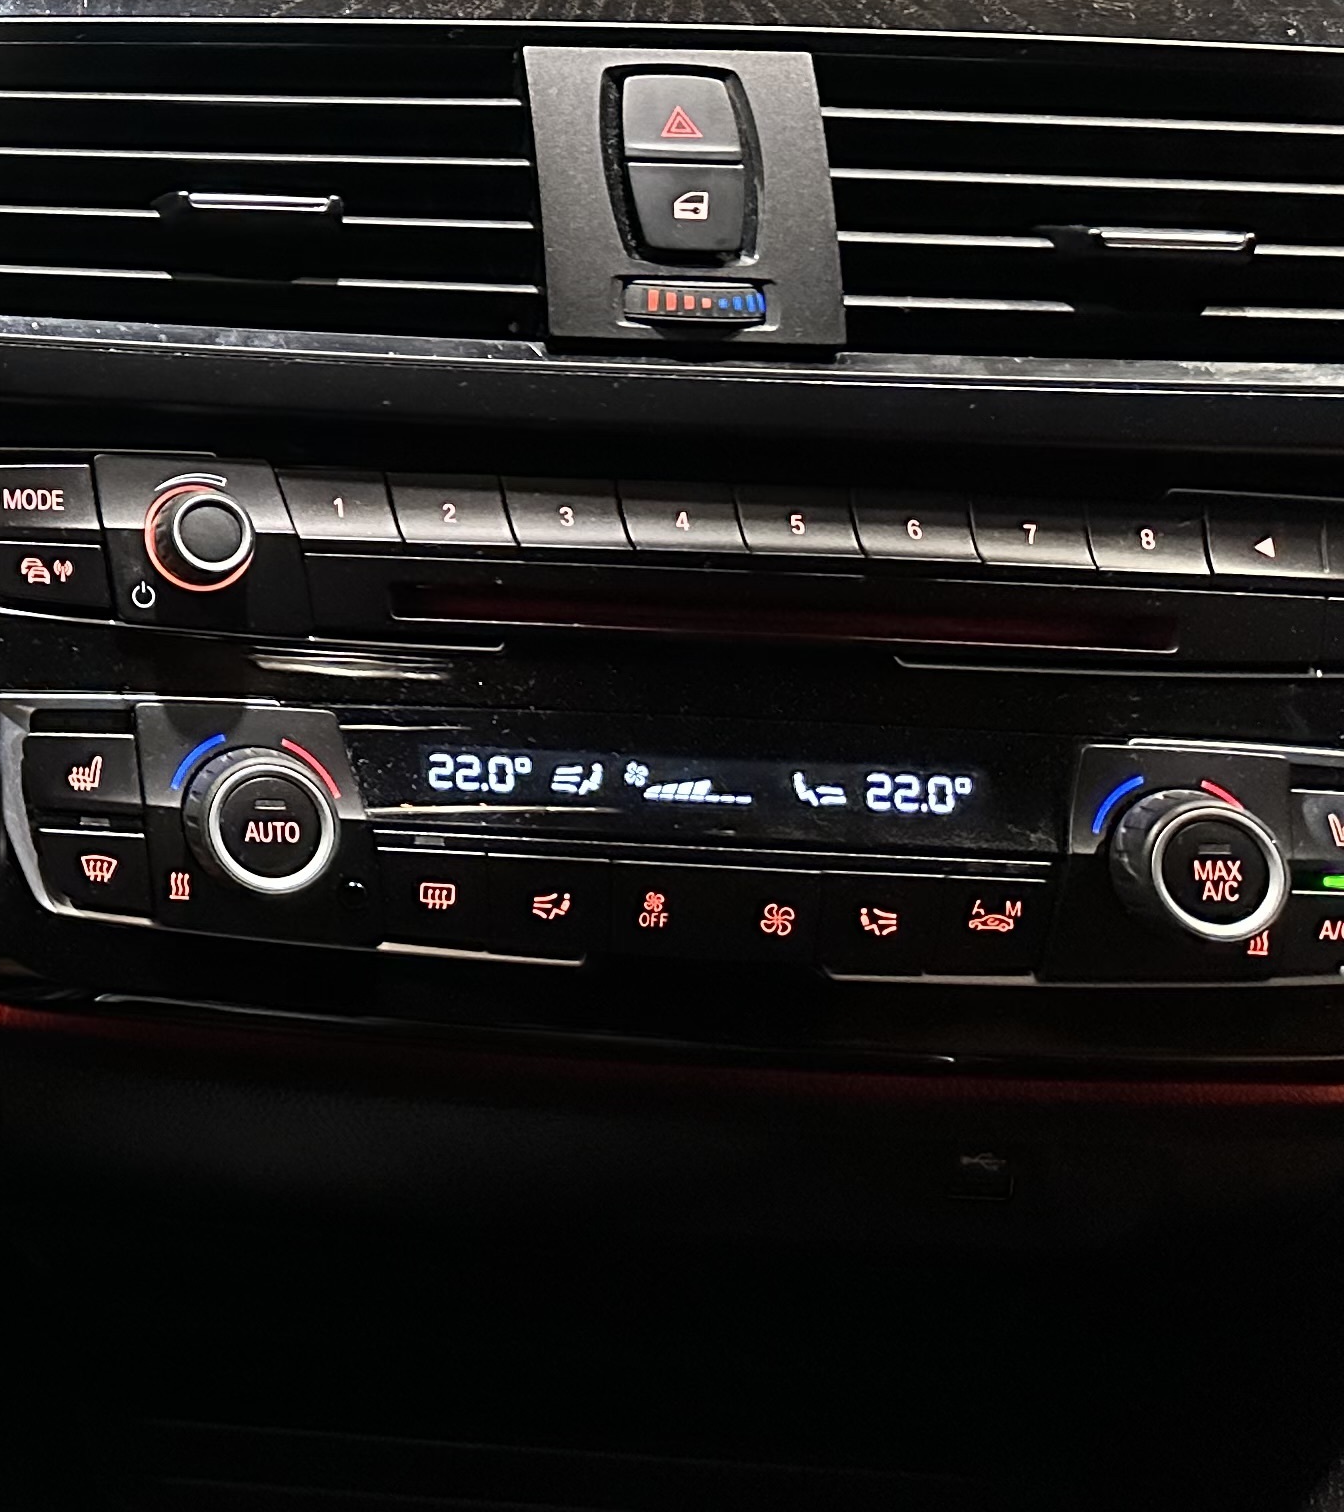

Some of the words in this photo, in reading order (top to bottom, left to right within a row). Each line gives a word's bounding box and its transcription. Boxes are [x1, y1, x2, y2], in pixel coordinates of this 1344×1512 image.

[2, 489, 64, 512] MODE
[333, 497, 344, 518] 1
[442, 503, 457, 523] 2
[559, 506, 575, 527] 3
[675, 511, 690, 531] 4
[790, 515, 806, 535] 5
[907, 520, 923, 540] 6
[1023, 524, 1038, 545] 7
[1140, 529, 1156, 550] 8
[244, 821, 301, 843] AUTO
[1193, 859, 1243, 882] MAX
[1202, 880, 1240, 902] A/C
[638, 911, 669, 928] OFF
